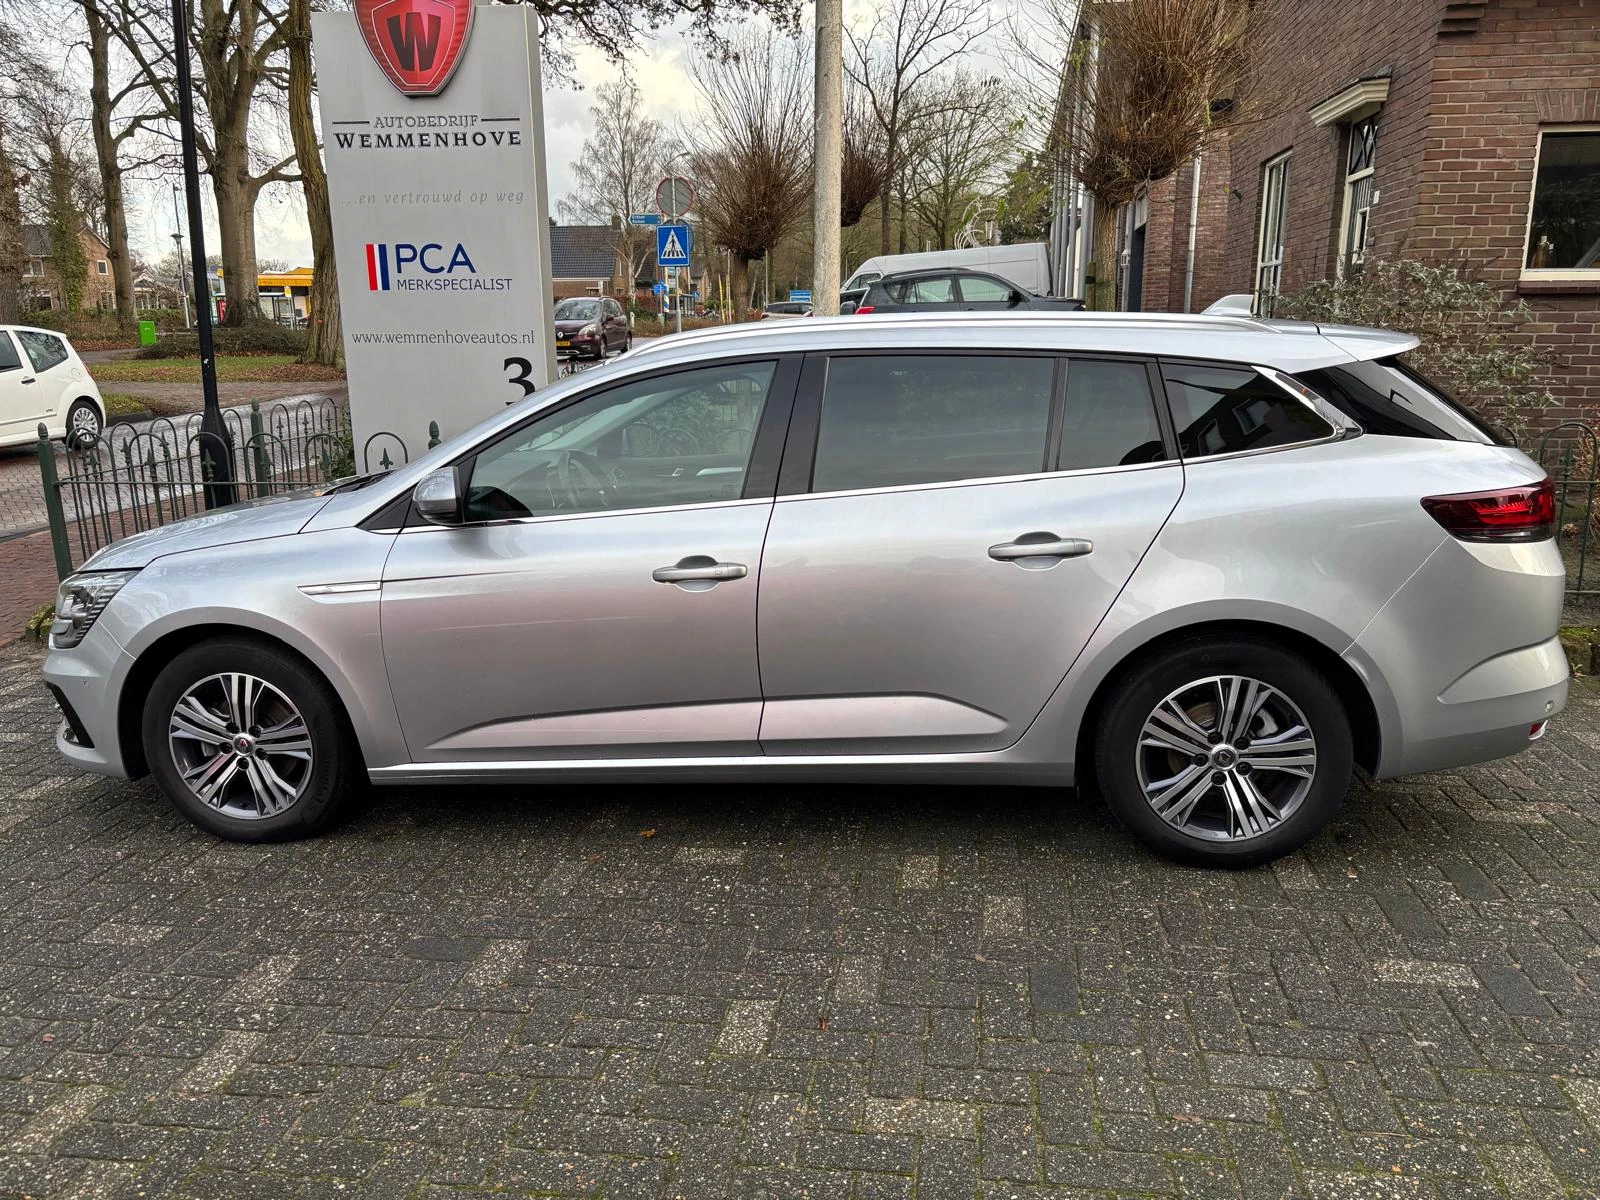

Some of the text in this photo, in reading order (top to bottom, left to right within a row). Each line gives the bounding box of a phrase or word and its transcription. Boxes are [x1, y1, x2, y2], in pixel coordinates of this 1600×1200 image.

[386, 12, 441, 72] W
[374, 115, 478, 128] AUTOBEDRIJF
[334, 131, 521, 148] WEMMENHOVE
[385, 190, 462, 203] vertrouwd
[470, 193, 488, 205] op
[496, 191, 524, 204] weg
[395, 243, 476, 273] PCA
[397, 278, 513, 291] MERKSPECIALIST
[352, 330, 535, 344] www.wemmenhoveautos.nl
[504, 357, 536, 406] 3
